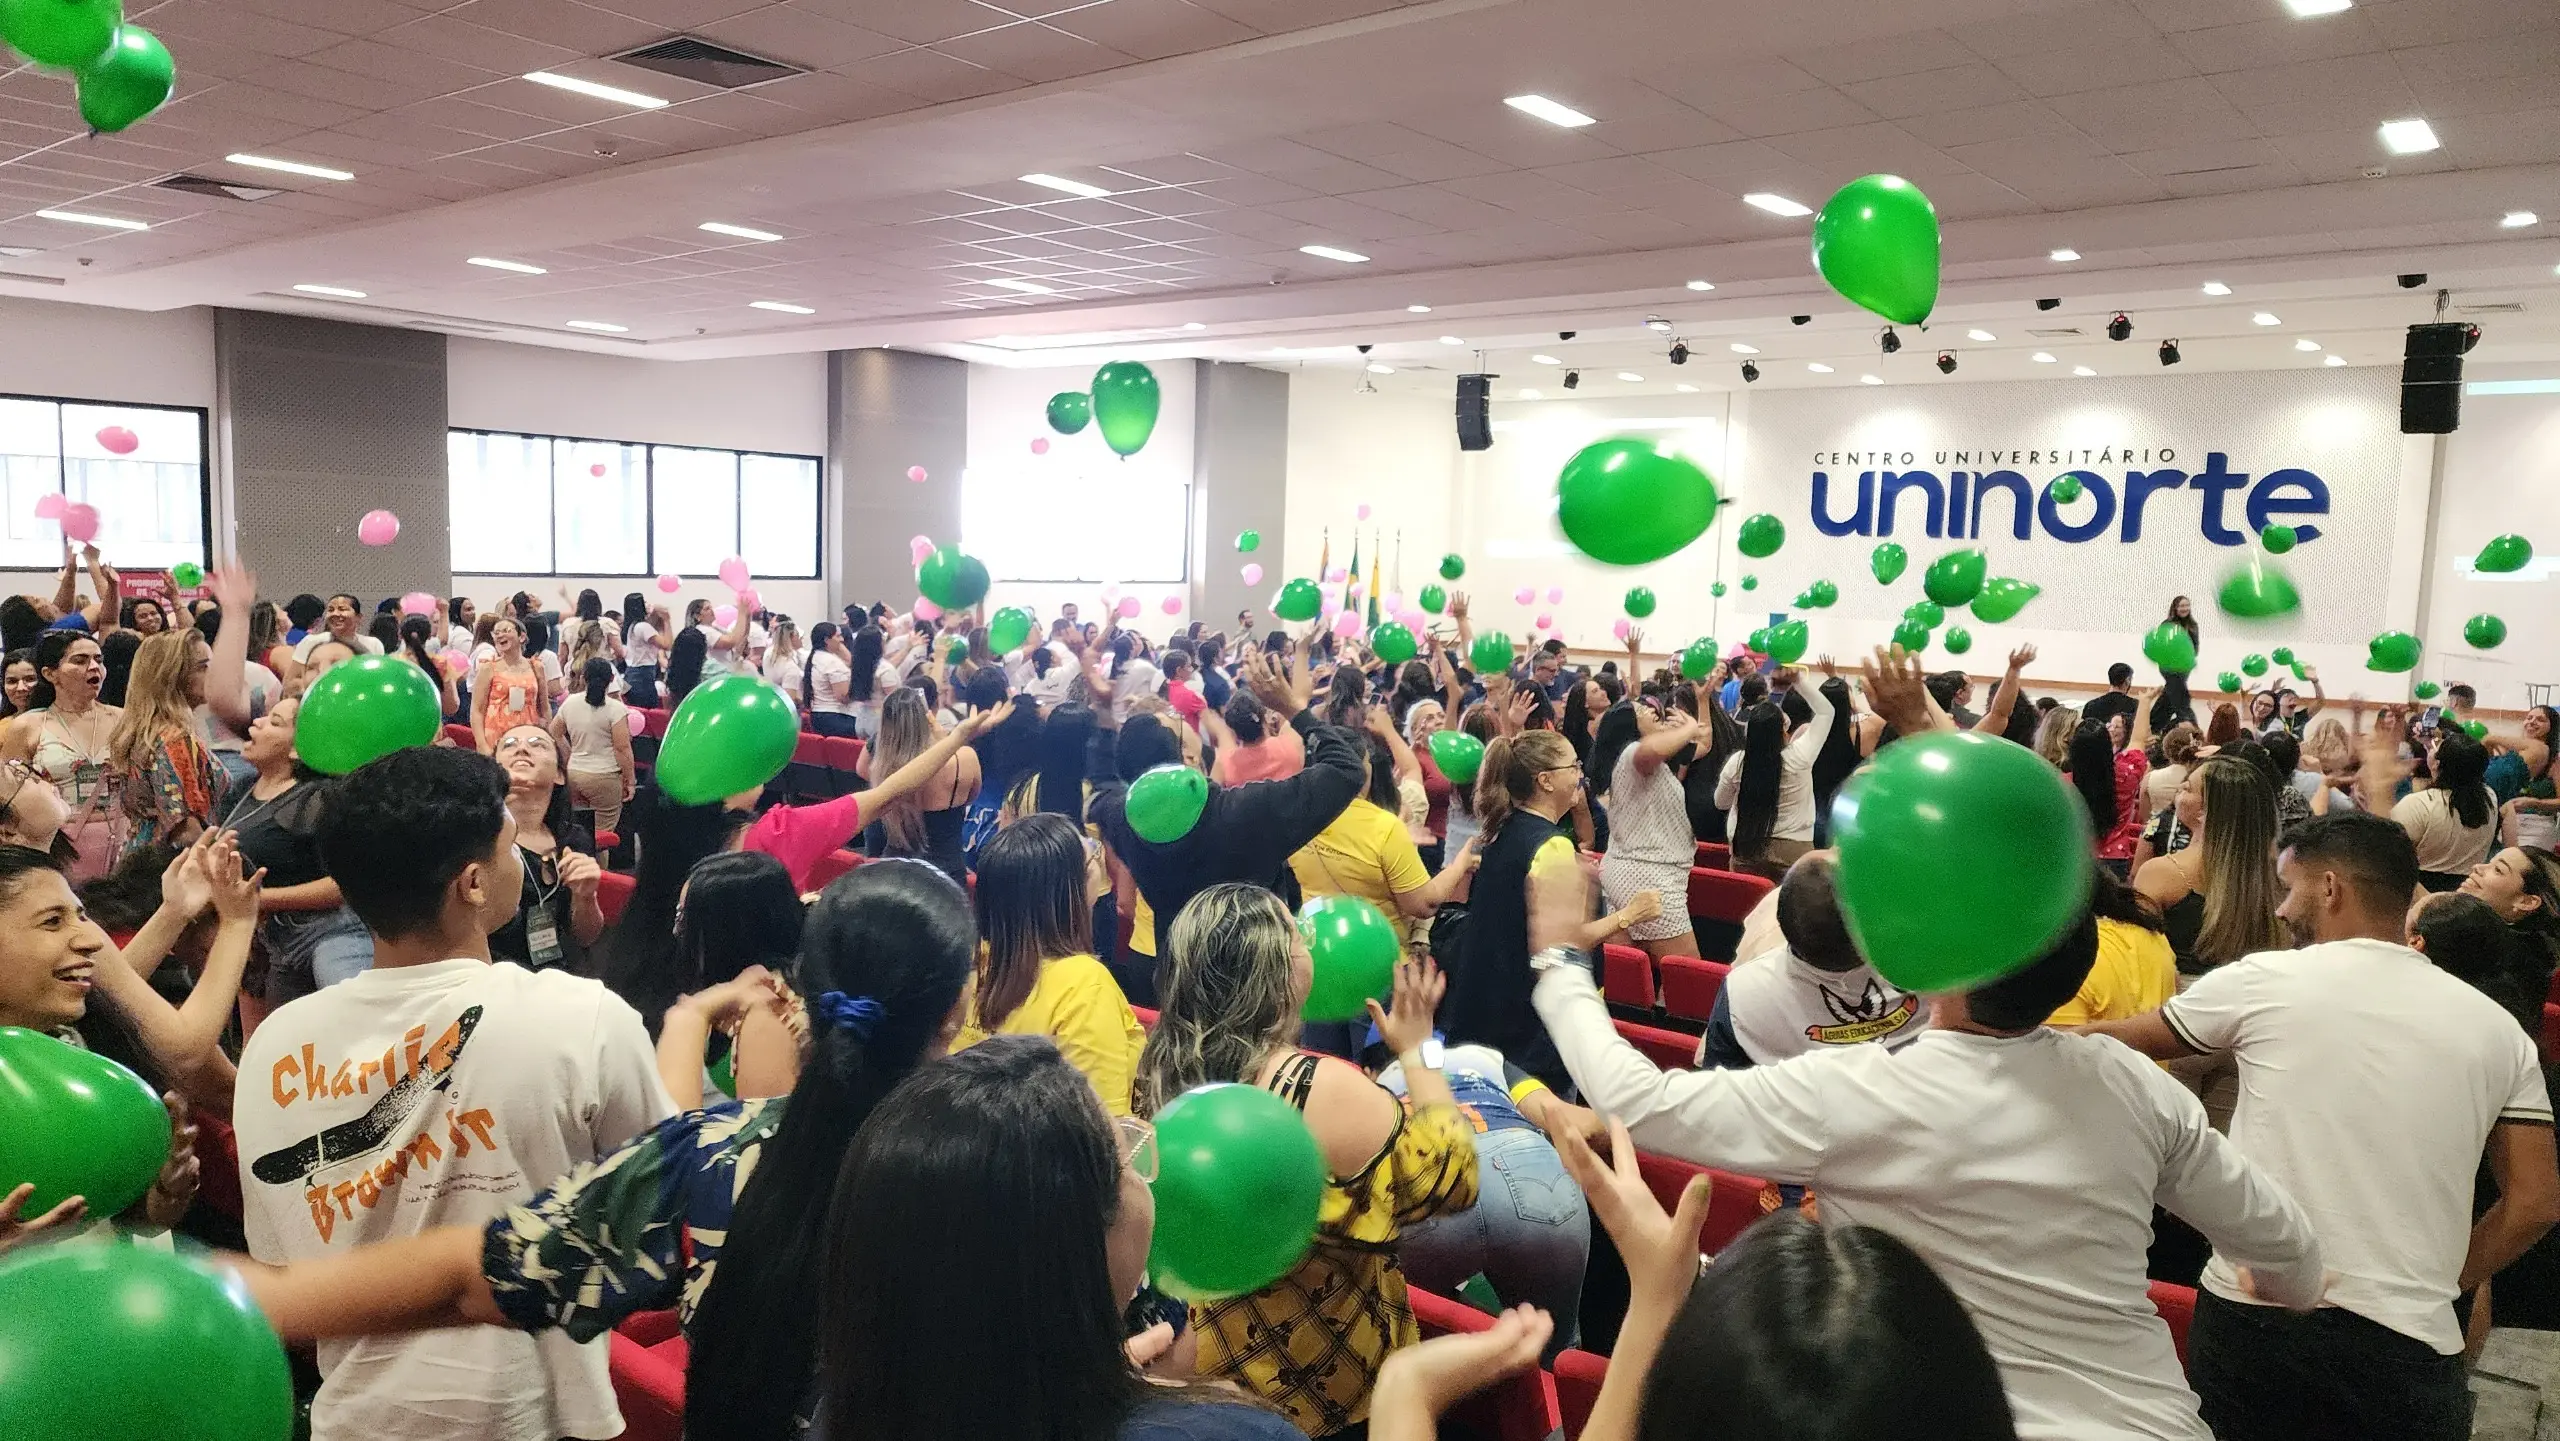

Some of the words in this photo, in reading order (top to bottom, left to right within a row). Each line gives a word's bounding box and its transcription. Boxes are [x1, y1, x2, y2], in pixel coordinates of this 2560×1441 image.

[1811, 452, 2331, 546] uninorte
[1814, 452, 1914, 465] CENTRO
[1936, 447, 2176, 465] UNIVERSITÁRIO
[272, 1023, 460, 1109] Charlie
[307, 1132, 443, 1244] Brown
